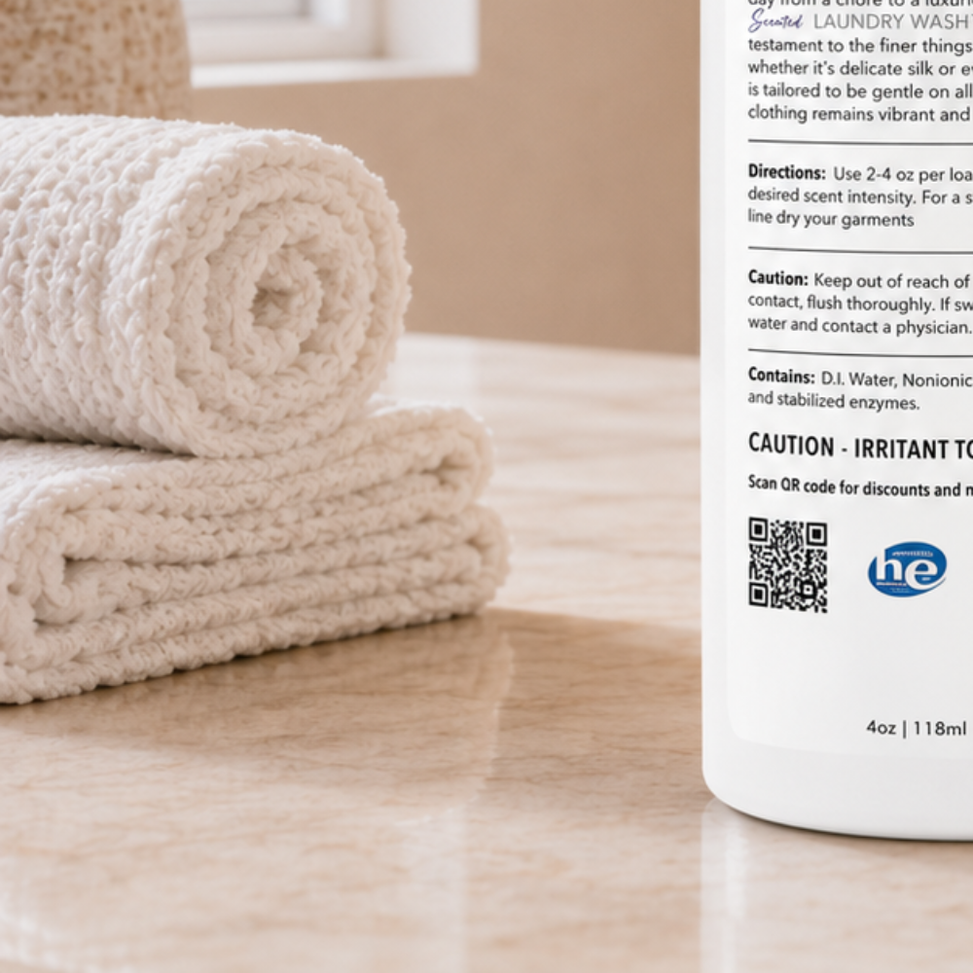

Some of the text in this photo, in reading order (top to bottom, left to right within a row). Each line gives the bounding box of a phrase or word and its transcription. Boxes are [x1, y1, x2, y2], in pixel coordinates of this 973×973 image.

[748, 39, 823, 52] testament
[827, 40, 845, 53] to
[849, 37, 875, 53] the
[879, 37, 917, 53] finer
[922, 37, 973, 57] things
[747, 104, 807, 125] clothing
[812, 106, 874, 122] remains
[878, 106, 935, 122] vibrant
[939, 106, 971, 122] and
[748, 163, 826, 181] Directions:
[834, 166, 862, 181] Use
[866, 166, 891, 182] 2-4
[896, 170, 914, 182] oz
[919, 171, 945, 185] per
[747, 186, 799, 202] desired
[803, 191, 843, 203] scent
[848, 189, 917, 208] intensity.
[922, 189, 948, 205] For
[951, 193, 961, 204] a
[748, 208, 915, 230] line dry your garments
[748, 268, 809, 286] Caution:
[814, 272, 853, 291] Keep
[856, 275, 883, 289] out
[887, 273, 903, 289] of
[907, 274, 949, 289] reach
[954, 274, 971, 289] of
[747, 317, 972, 338] water and contact a physician.
[748, 366, 815, 385] Contains:
[821, 371, 845, 386] D.I.
[848, 372, 898, 389] Water,
[903, 373, 973, 388] Nonionic
[747, 390, 920, 413] and stabilized enzymes.
[748, 431, 834, 457] CAUTION
[855, 437, 950, 460] IRRITANT
[748, 473, 777, 490] Scan
[780, 476, 801, 492] QR
[803, 479, 836, 495] code
[839, 479, 860, 495] for
[862, 481, 931, 497] discounts
[933, 482, 961, 497] and
[876, 547, 938, 590] he
[866, 720, 967, 736] 4oz 118ml
